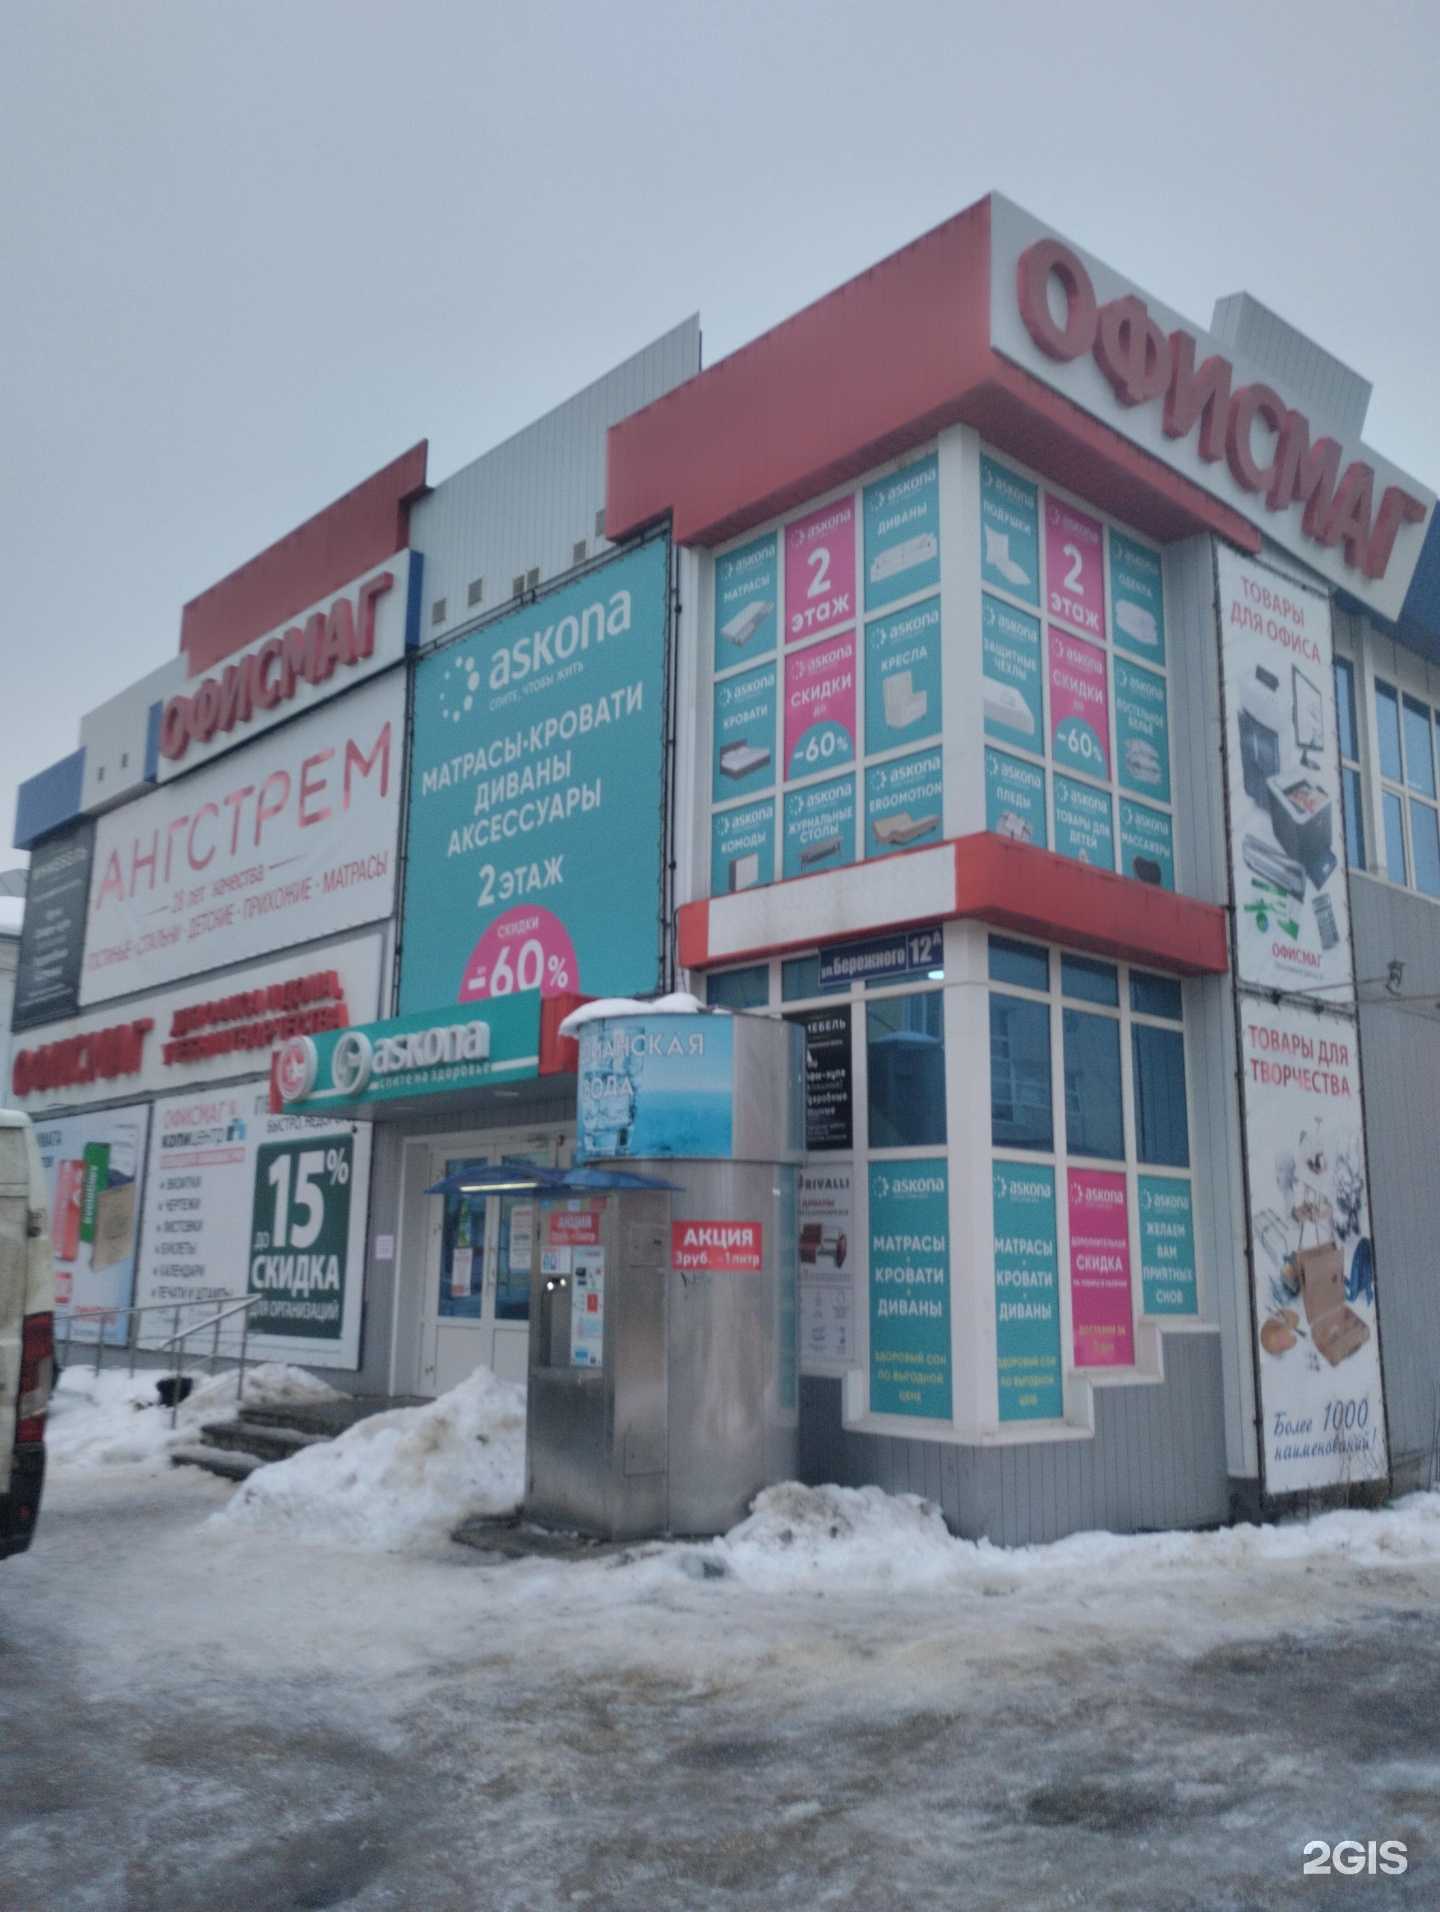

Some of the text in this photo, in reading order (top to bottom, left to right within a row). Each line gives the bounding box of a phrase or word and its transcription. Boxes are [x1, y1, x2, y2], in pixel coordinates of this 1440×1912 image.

[1018, 238, 1428, 581] ОФИСМАГ
[888, 467, 937, 505] askona
[878, 503, 928, 537] ДИВАНЫ
[807, 547, 832, 599] 2
[1063, 543, 1084, 596] 2
[724, 574, 770, 602] МАТРАСЫ
[1241, 576, 1304, 629] ТОВАРЫ
[889, 610, 938, 640] askona
[1231, 600, 1320, 664] ДЛЯ ОФИСА
[488, 589, 632, 690] askona
[160, 571, 394, 761] ОФИСМАГ
[808, 645, 852, 671] askona
[881, 646, 928, 672] КРЕСЛА
[734, 674, 775, 699] askona
[723, 705, 768, 730] КРОВАТИ
[474, 750, 572, 816] ДИВАНЫ
[890, 755, 941, 784] askona
[807, 783, 852, 807] askona
[96, 720, 391, 912] АНГСТРЕМ
[447, 779, 601, 858] АКСЕССУАРЫ
[732, 806, 773, 829] askona
[721, 832, 767, 854] КОМОДЫ
[800, 825, 840, 844] СТОЛЫ
[322, 850, 391, 894] МАТРАСЫ
[477, 854, 566, 908] 2 ЭТАЖ
[1272, 942, 1322, 969] ОФИСМАГ
[372, 1021, 491, 1074] askona
[1248, 1024, 1350, 1068] ТОВАРЫ ДЛЯ
[1250, 1058, 1351, 1097] ТВОРЧЕСТВА
[269, 1148, 349, 1249] 15%
[892, 1177, 944, 1193] askona
[1009, 1179, 1052, 1198] askona
[1085, 1186, 1124, 1205] askona
[683, 1228, 753, 1248] АКЦИЯ
[873, 1235, 945, 1252] МАТРАСЫ
[994, 1236, 1053, 1257] МАТРАСЫ
[1156, 1245, 1178, 1259] ВАМ
[252, 1254, 340, 1299] СКИДКА
[875, 1268, 944, 1285] КРОВАТИ
[1076, 1254, 1123, 1273] СКИДКА
[996, 1270, 1053, 1289] КРОВАТИ
[878, 1300, 942, 1318] ДИВАНЫ
[1156, 1290, 1184, 1304] СНОВ
[1000, 1302, 1052, 1322] ДИВАНЫ
[1274, 1399, 1369, 1436] Более 1000
